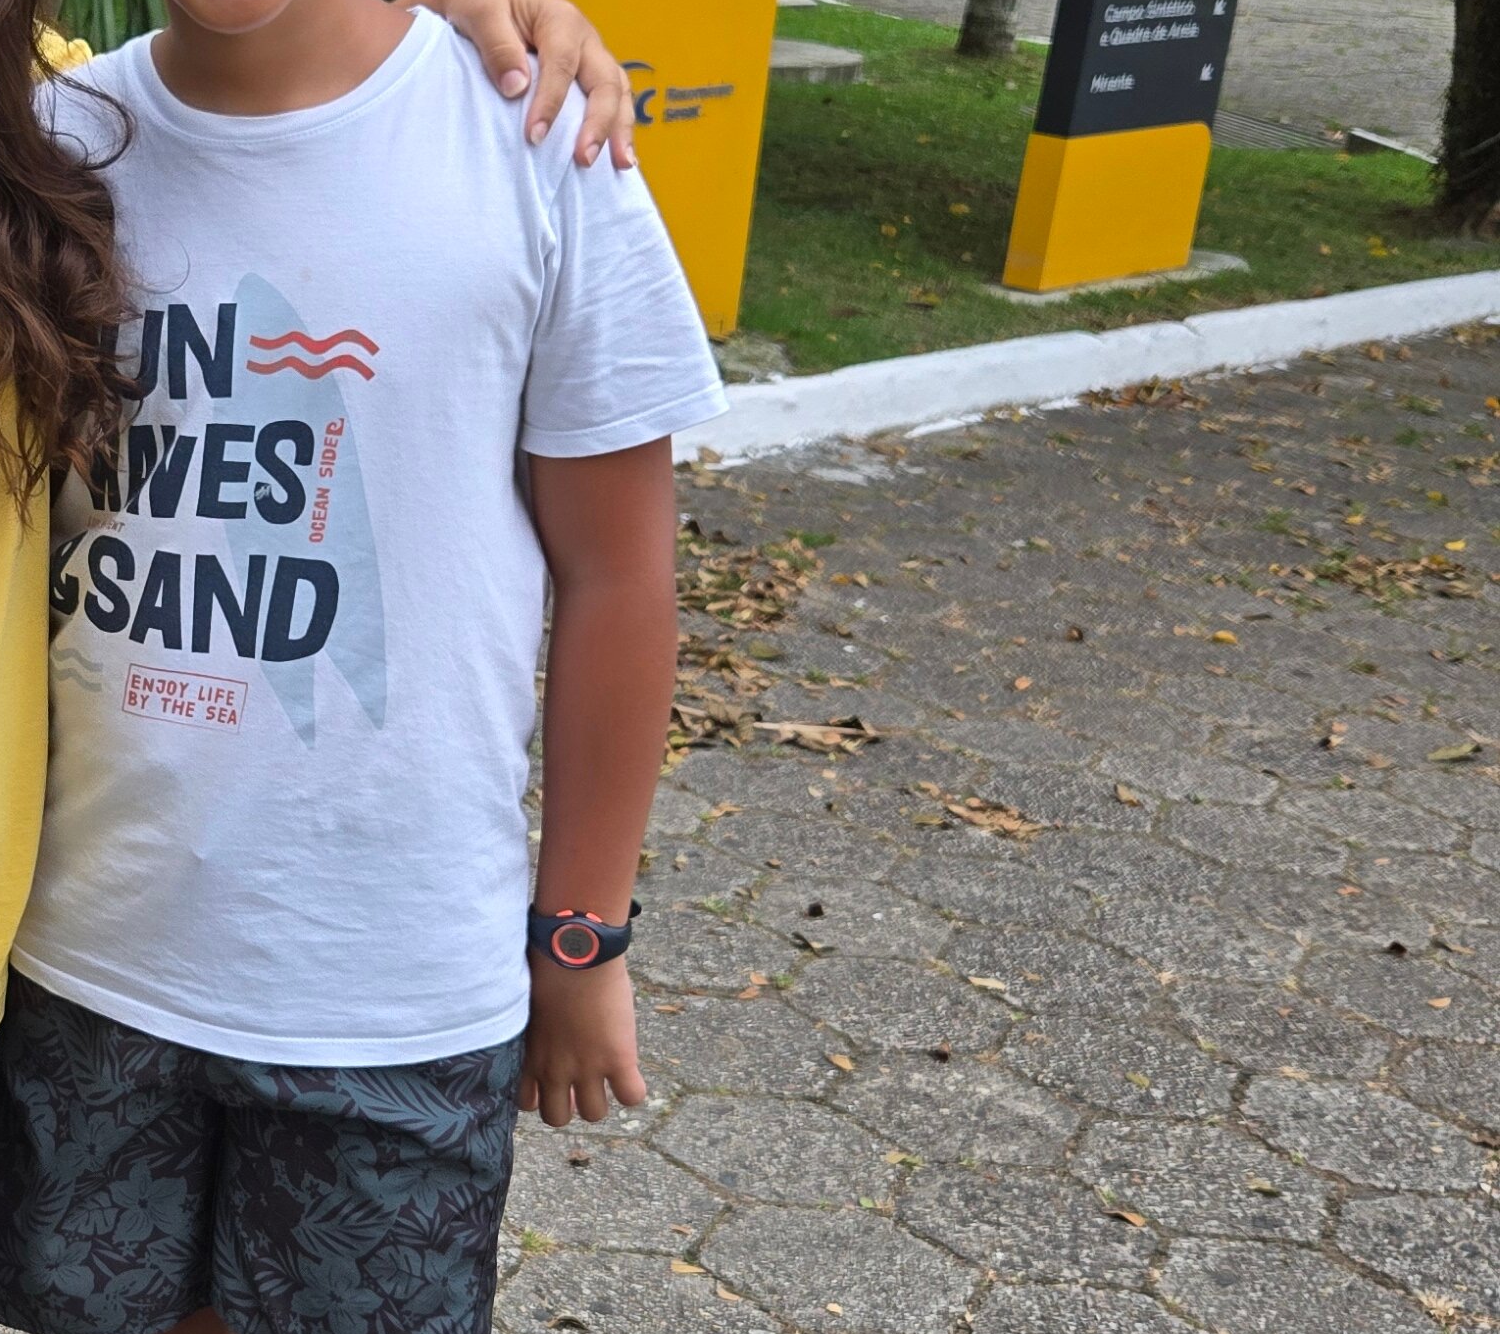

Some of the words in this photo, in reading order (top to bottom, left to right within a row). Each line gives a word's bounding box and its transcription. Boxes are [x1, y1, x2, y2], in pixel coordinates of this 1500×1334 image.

[1104, 4, 1146, 23] Campo
[1110, 25, 1152, 46] Quadra
[1090, 73, 1136, 94] Mirante
[308, 487, 331, 544] OCEAN
[130, 674, 189, 698] ENJOY
[197, 685, 235, 707] LIFE
[127, 690, 150, 710] BY
[161, 697, 196, 718] THE
[205, 706, 237, 726] SEA
